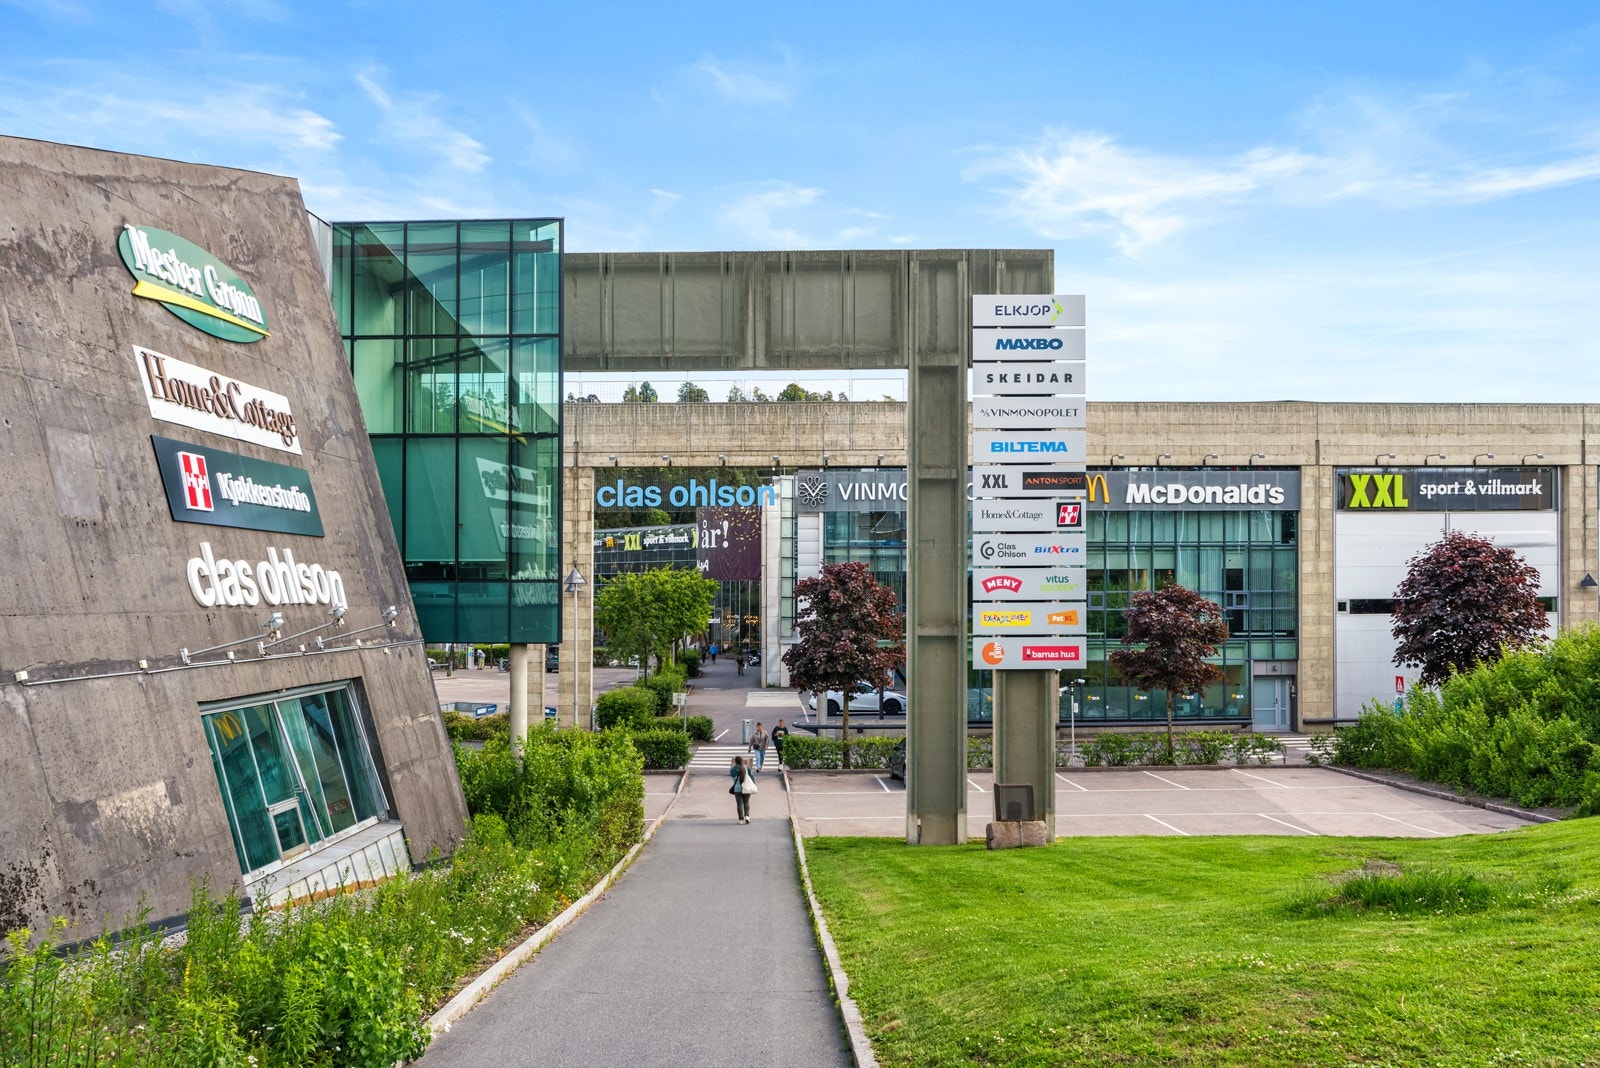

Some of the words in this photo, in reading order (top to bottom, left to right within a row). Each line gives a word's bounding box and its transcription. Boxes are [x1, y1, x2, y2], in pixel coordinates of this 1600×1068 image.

[124, 224, 204, 297] Mester
[995, 338, 1064, 350] MAXBO
[986, 373, 1073, 383] SKEIDAR
[990, 408, 1079, 417] VINMONOPOLET
[990, 441, 1068, 453] BILTEMA
[981, 474, 1008, 489] XXL
[215, 472, 311, 513] Kjøkkenstudio
[597, 479, 663, 508] clas
[669, 478, 775, 508] ohlson
[1125, 483, 1285, 505] McDonald's
[1349, 474, 1409, 508] XXL
[1419, 481, 1460, 499] sport
[1464, 480, 1478, 495] &
[1478, 478, 1543, 495] villmark
[981, 509, 1044, 522] Home&Cottage
[624, 533, 642, 551] XXL
[997, 542, 1017, 551] Clas
[997, 550, 1027, 559] Ohlson
[1034, 545, 1080, 555] BilXtra
[187, 542, 260, 607] clas
[256, 547, 348, 610] ohlson
[1045, 575, 1070, 583] vitus
[986, 578, 1019, 589] MENY
[1032, 650, 1059, 658] barnas
[1060, 650, 1075, 658] hus
